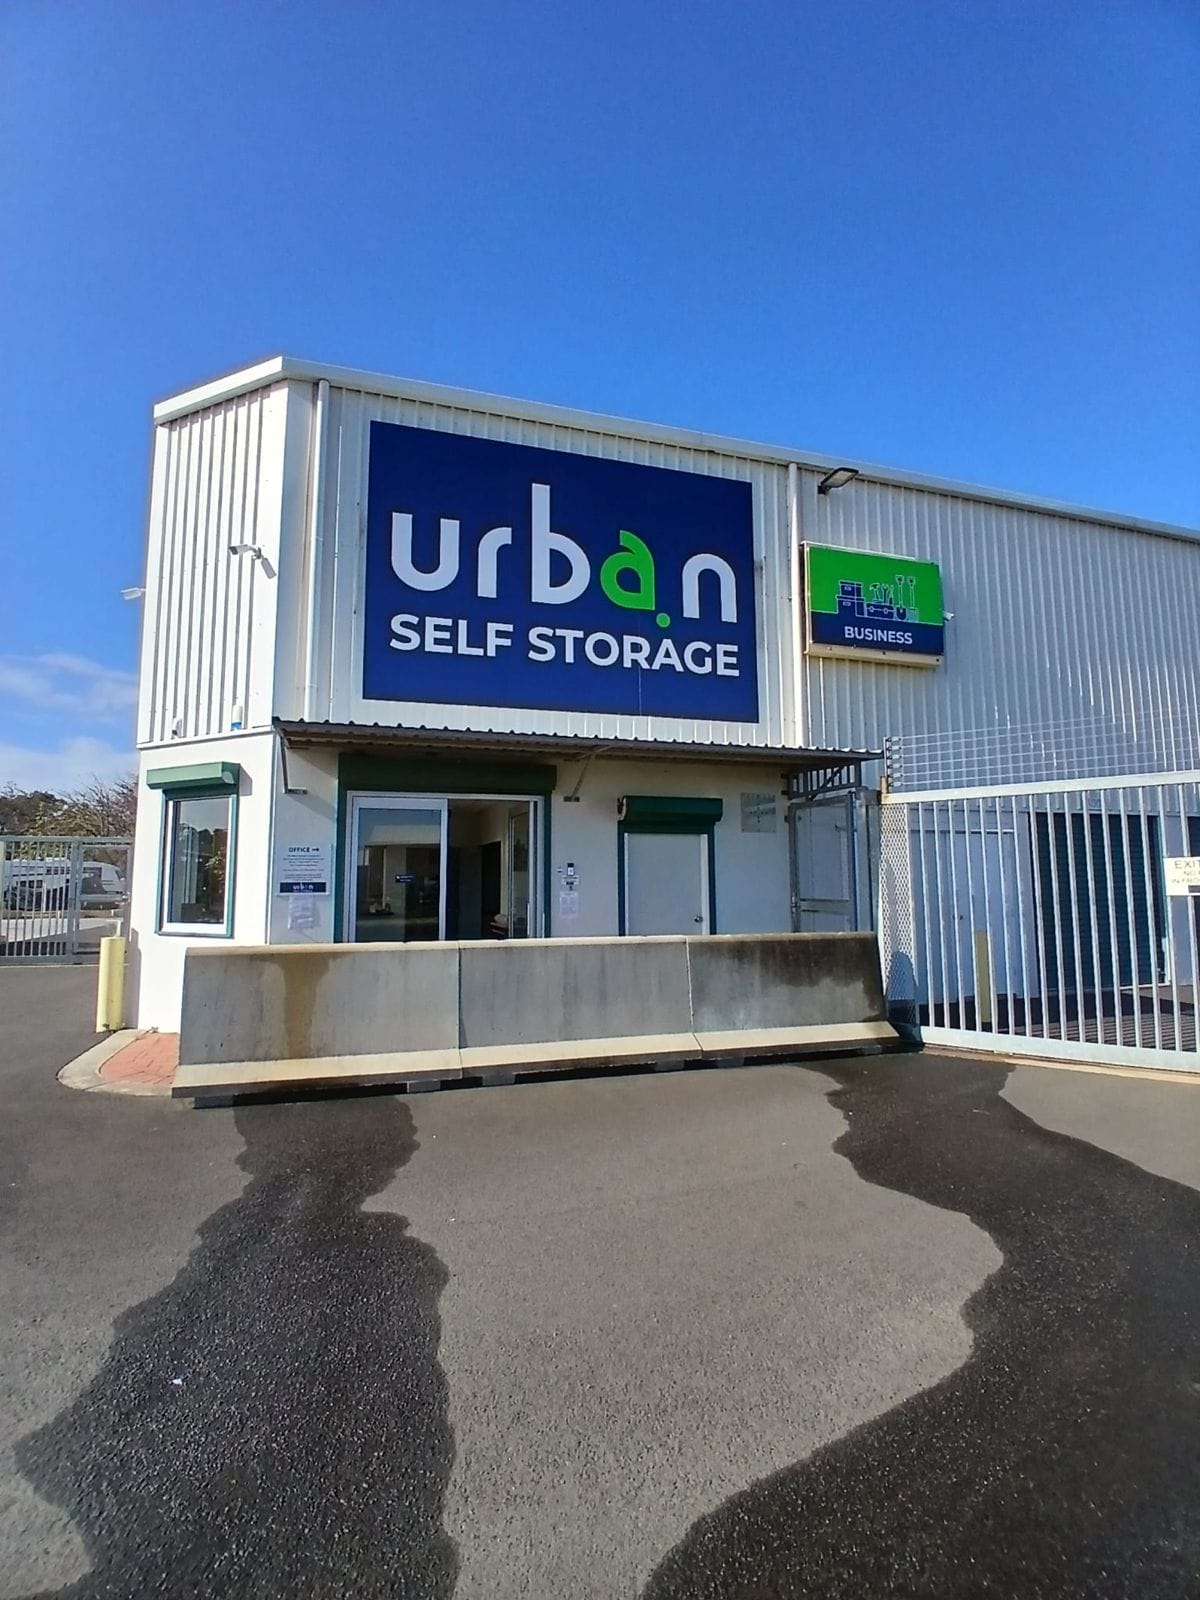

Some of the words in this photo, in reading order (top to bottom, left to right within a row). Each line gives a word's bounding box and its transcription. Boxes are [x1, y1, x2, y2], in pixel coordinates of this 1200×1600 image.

[390, 613, 513, 658] SELF
[528, 626, 740, 677] STORAGE
[844, 626, 913, 645] BUSINESS
